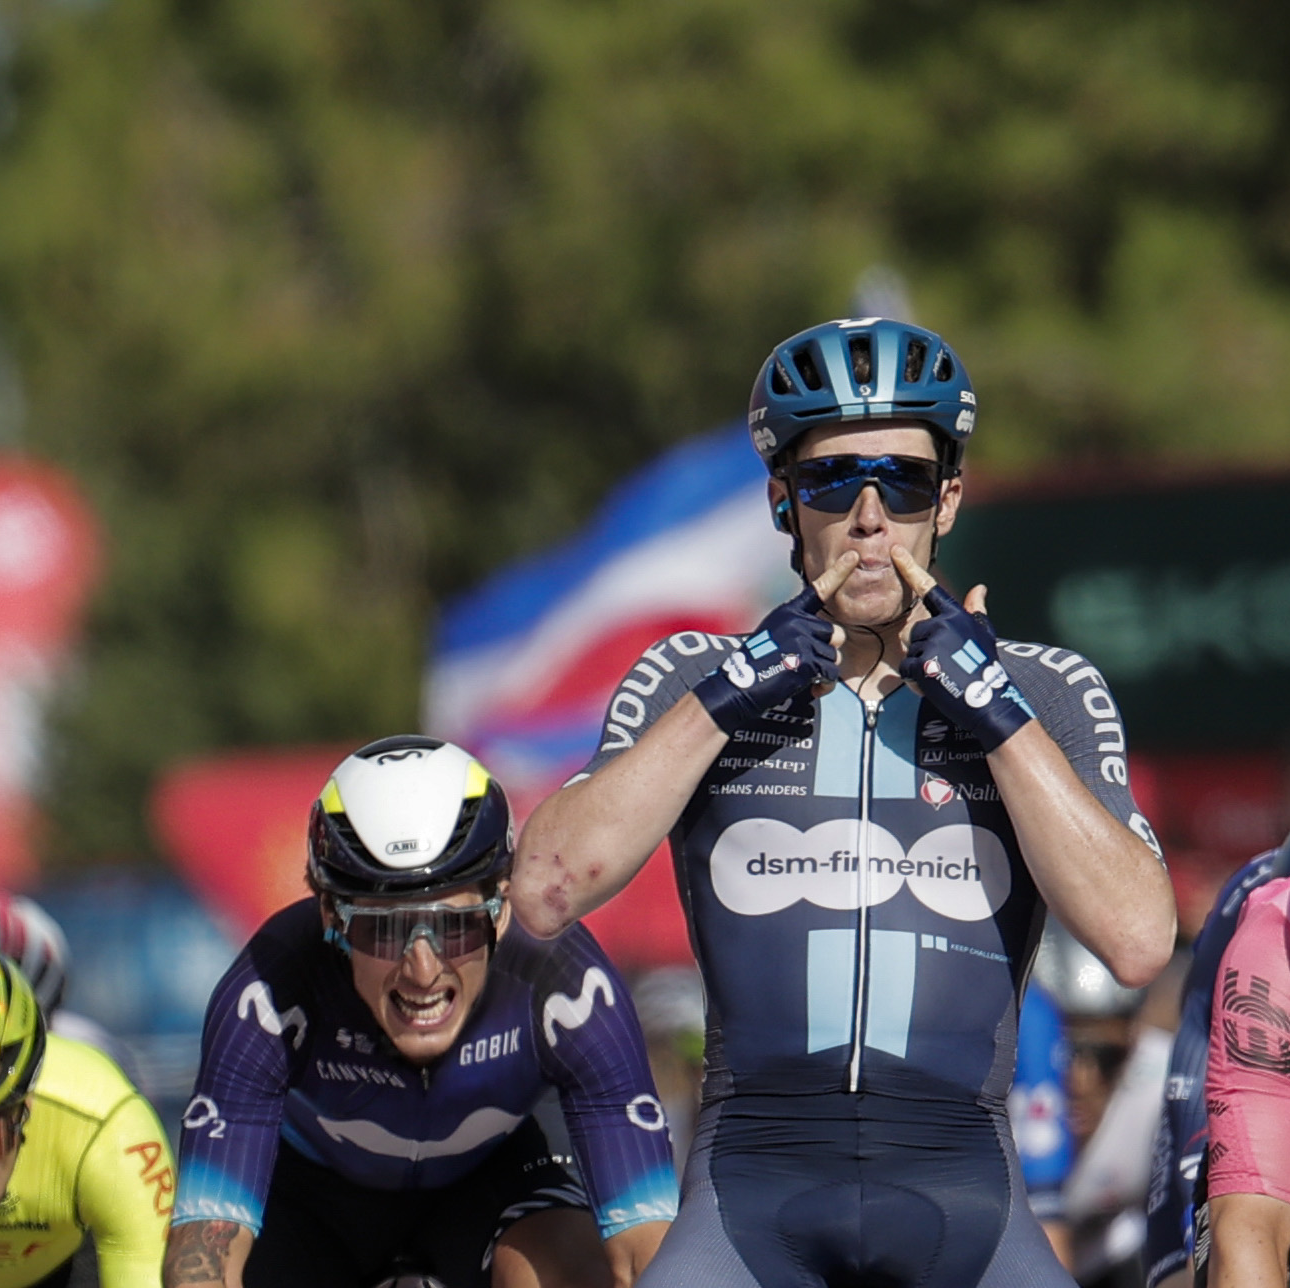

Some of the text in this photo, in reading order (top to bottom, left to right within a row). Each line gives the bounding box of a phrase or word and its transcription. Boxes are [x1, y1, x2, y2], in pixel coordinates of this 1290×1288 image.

[758, 662, 785, 682] Nalini
[936, 671, 964, 699] Nalini
[733, 730, 813, 749] SHIMANO
[721, 784, 807, 796] HANS ANDERS
[746, 851, 981, 882] dsm-firmenich
[460, 1027, 521, 1067] GOBIK
